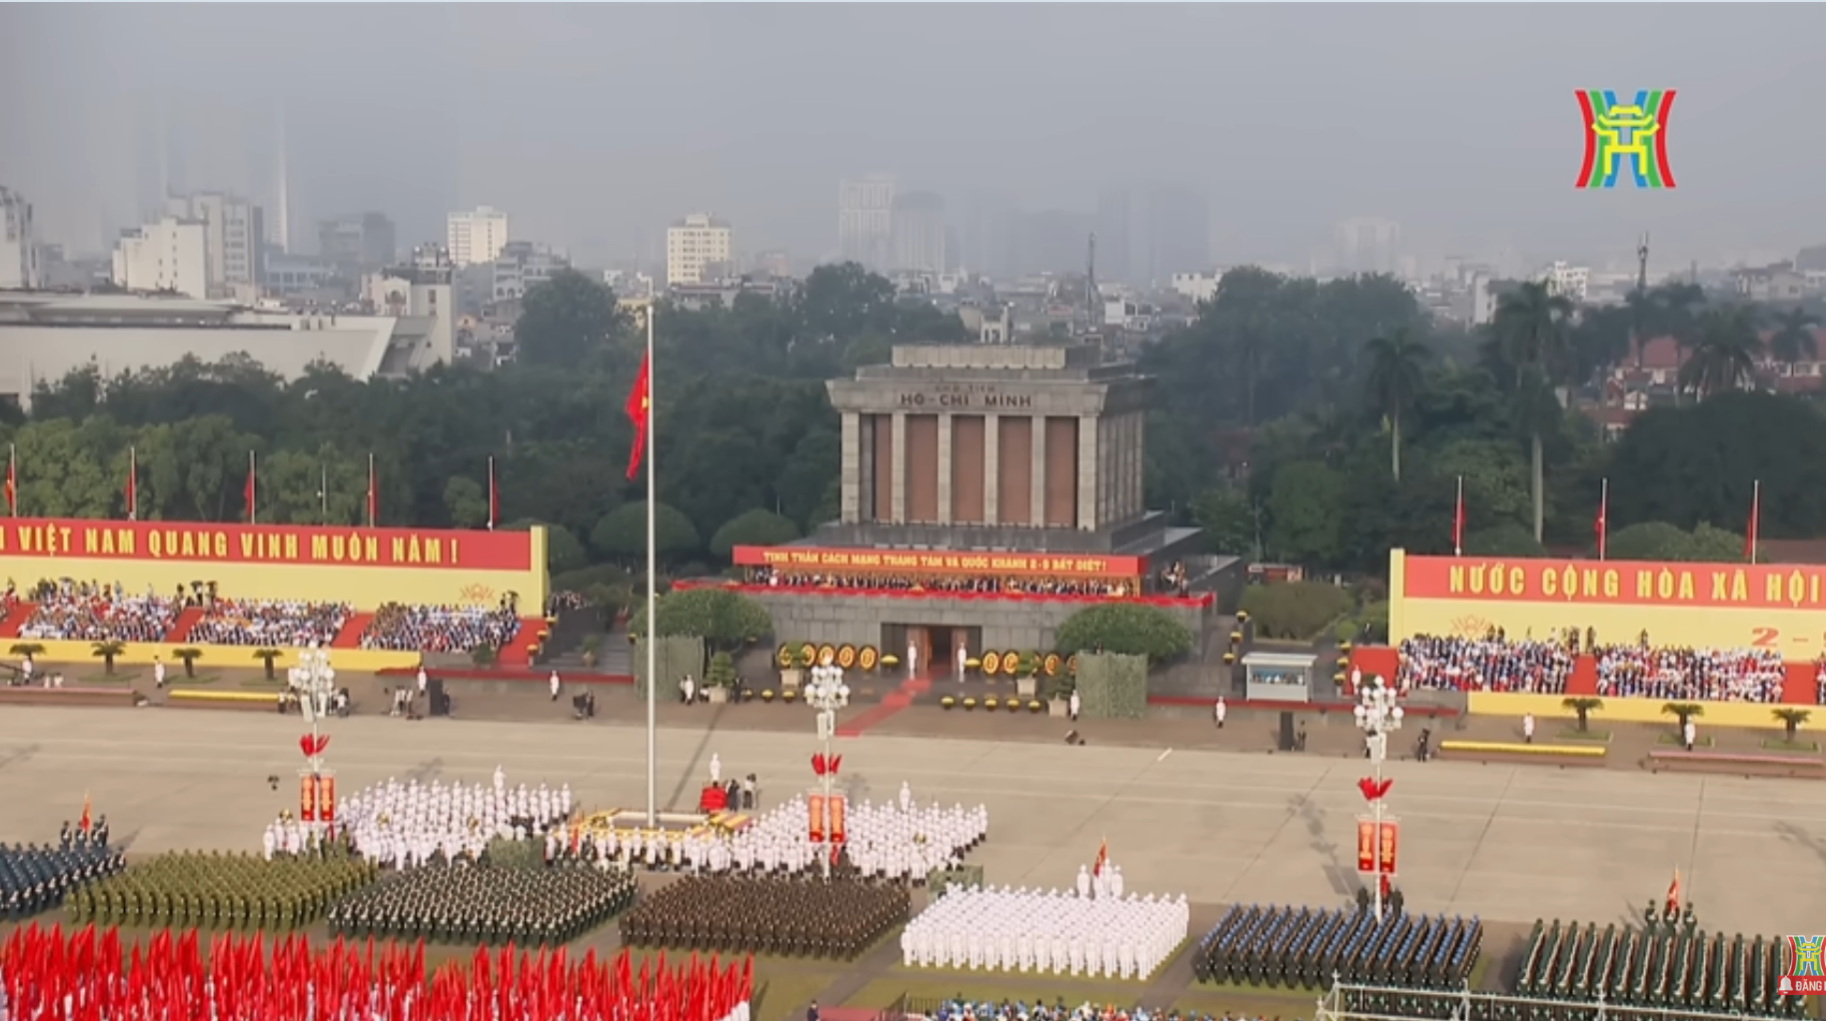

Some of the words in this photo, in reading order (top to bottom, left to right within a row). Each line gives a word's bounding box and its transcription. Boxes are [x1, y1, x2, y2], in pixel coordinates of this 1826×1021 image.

[984, 393, 1032, 407] MINH
[18, 522, 71, 557] VIỆT
[86, 528, 135, 554] NAM
[149, 529, 228, 558] QUANG
[241, 533, 298, 559] VINH
[312, 531, 378, 561] MUÔN
[1450, 562, 1525, 595] NƯỚC
[1542, 563, 1619, 602] CỘNG
[1637, 566, 1694, 599] HÒA
[1766, 568, 1820, 608] HỘI
